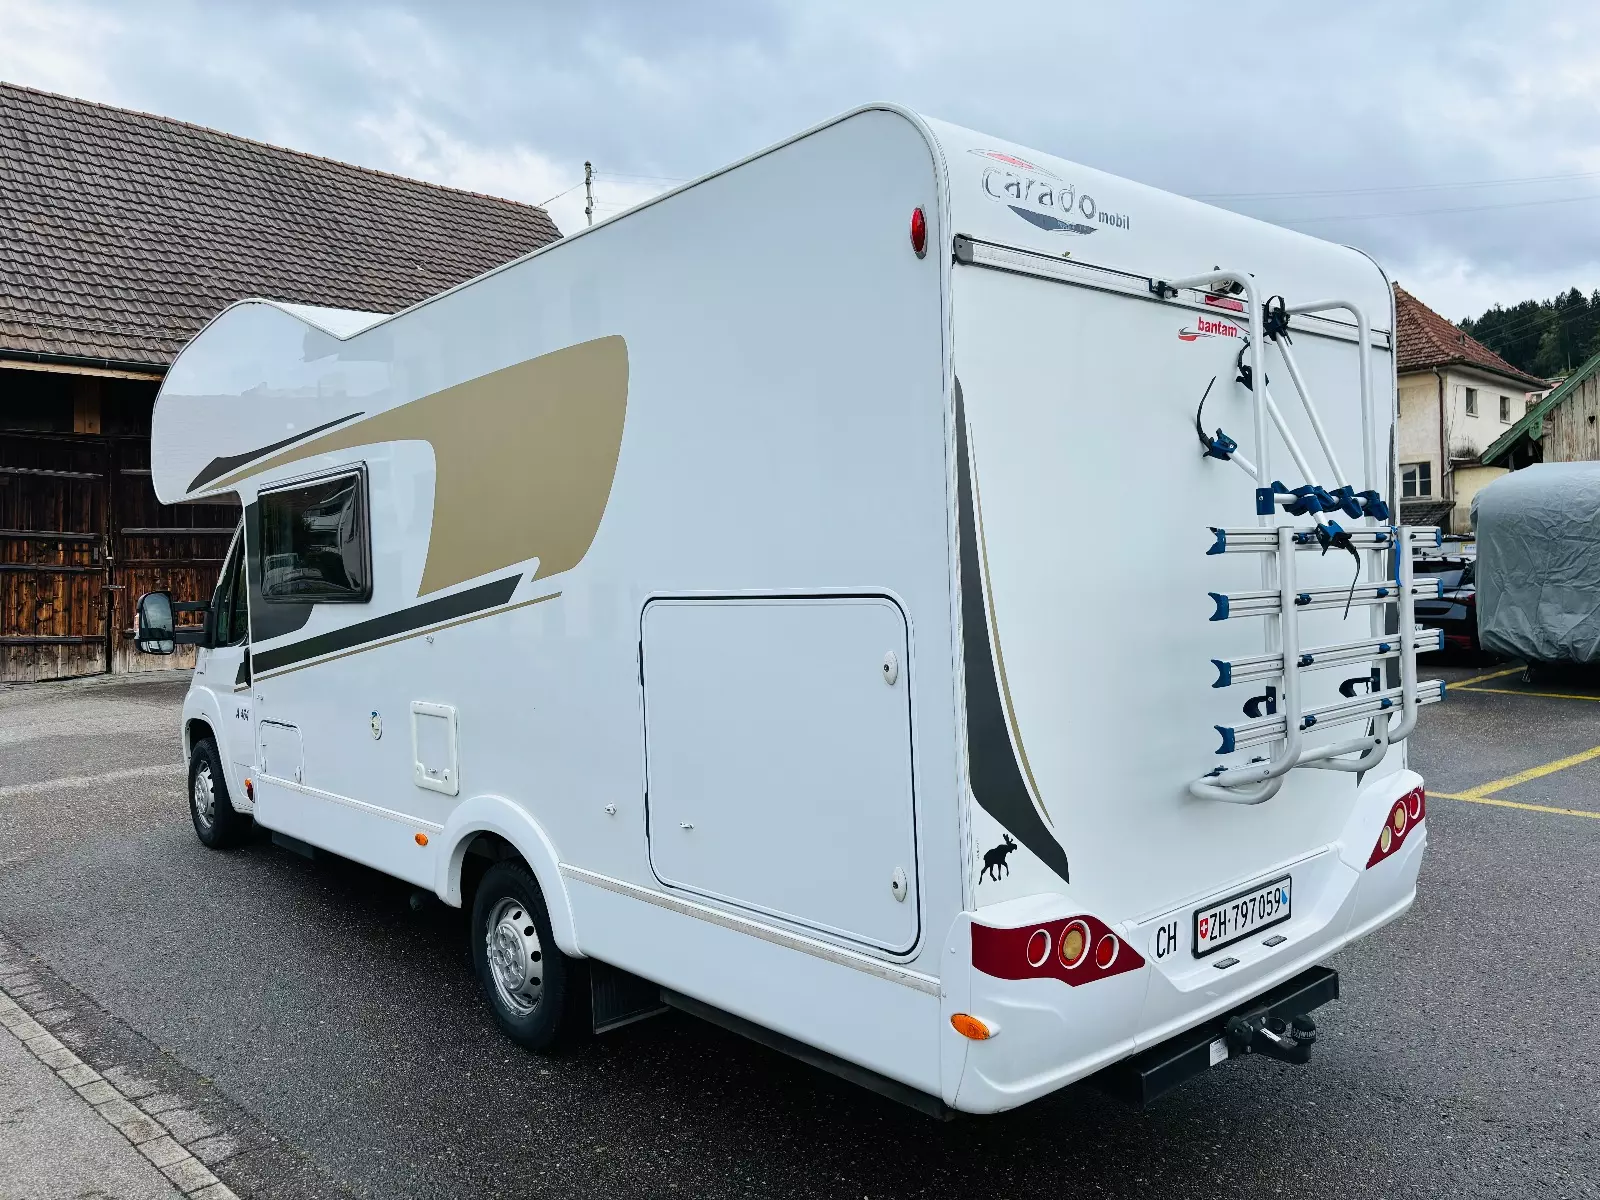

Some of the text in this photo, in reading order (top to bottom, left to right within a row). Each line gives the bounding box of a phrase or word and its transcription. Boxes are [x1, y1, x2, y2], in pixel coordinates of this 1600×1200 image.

[1098, 211, 1130, 230] mobil
[1197, 316, 1237, 337] bantam
[1156, 921, 1177, 959] CH
